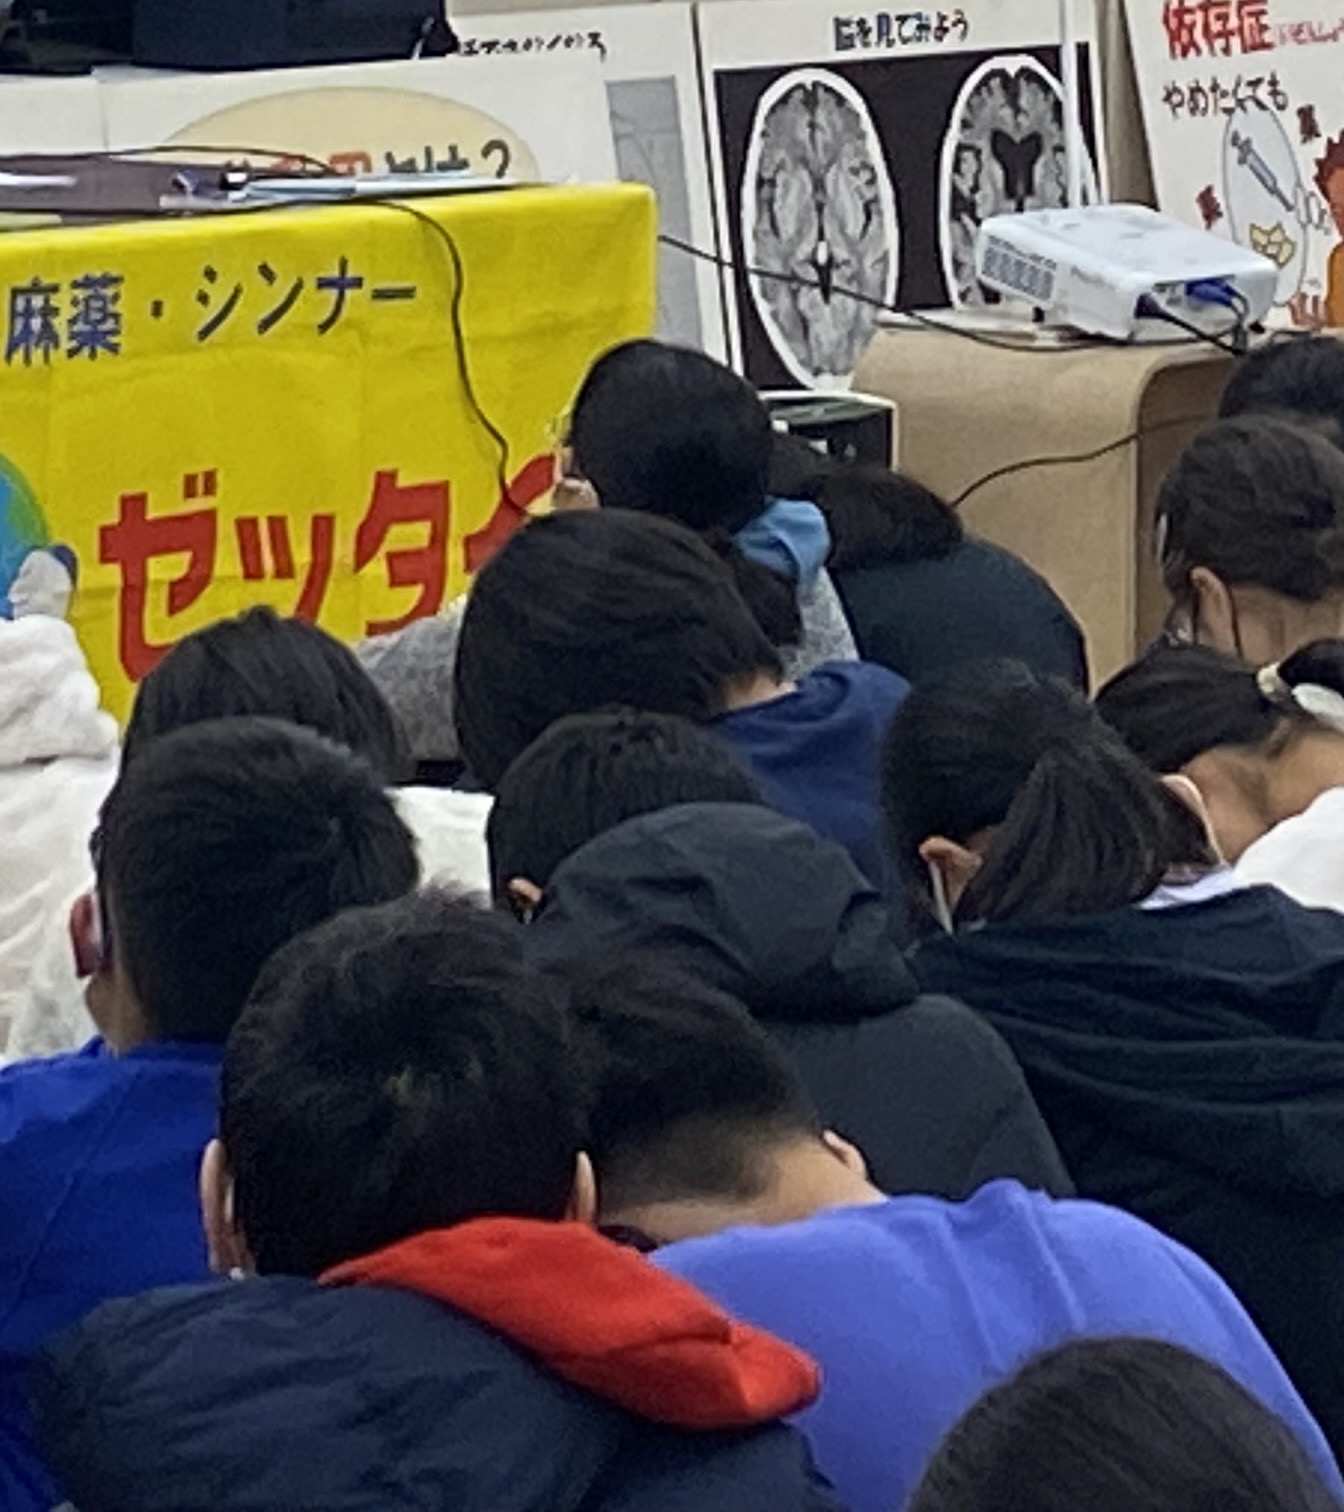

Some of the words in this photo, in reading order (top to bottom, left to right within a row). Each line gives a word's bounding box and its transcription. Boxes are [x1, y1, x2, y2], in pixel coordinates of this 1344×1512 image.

[1162, 69, 1290, 120] やめたくても
